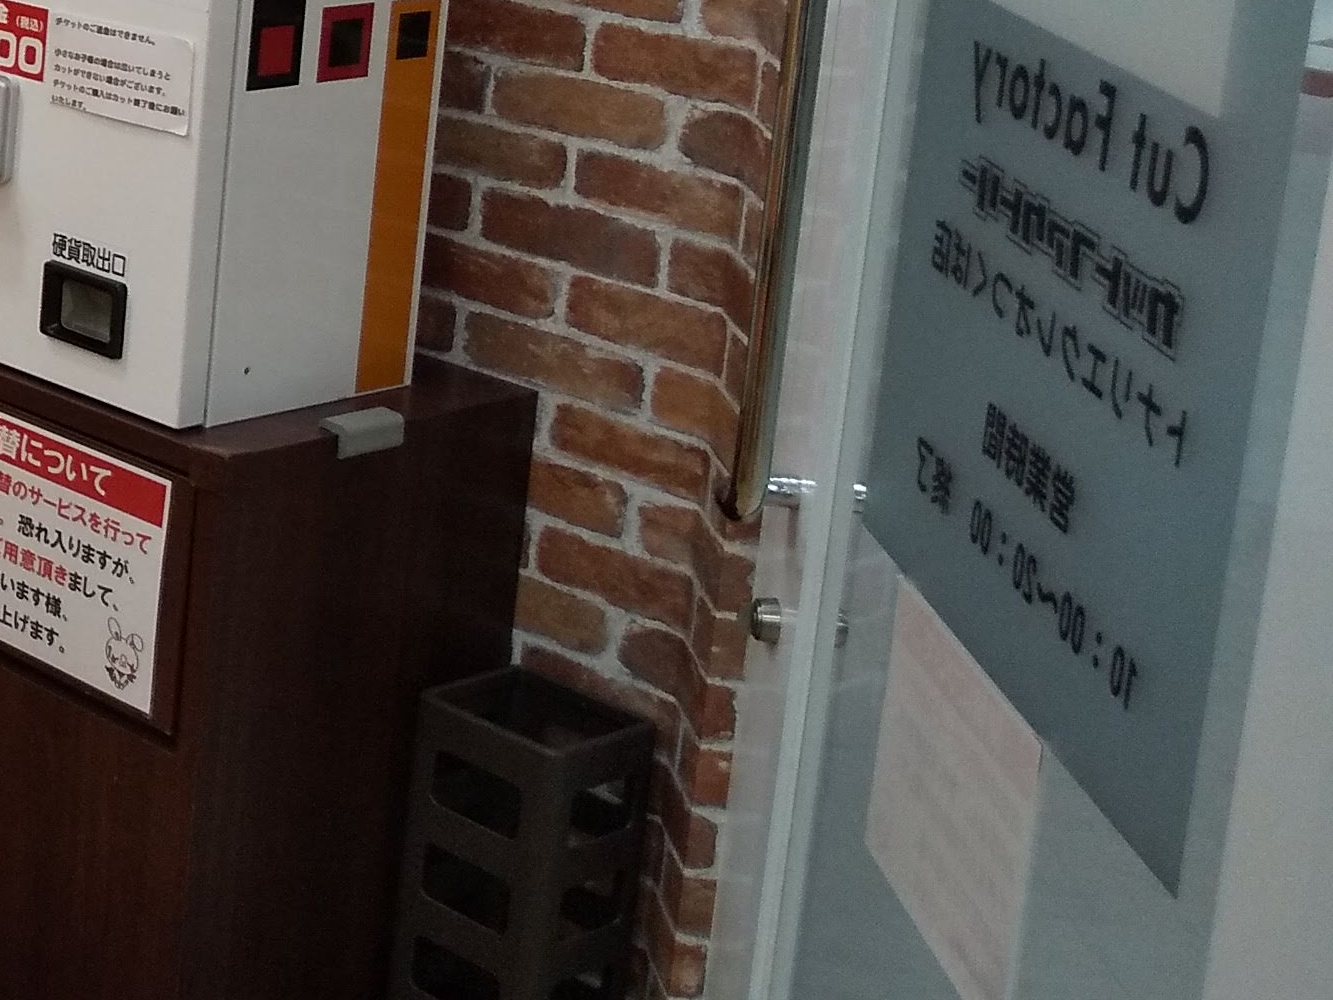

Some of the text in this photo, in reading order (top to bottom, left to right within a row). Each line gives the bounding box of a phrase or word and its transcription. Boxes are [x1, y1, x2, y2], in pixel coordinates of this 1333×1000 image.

[51, 233, 126, 278] 硬貨取出口
